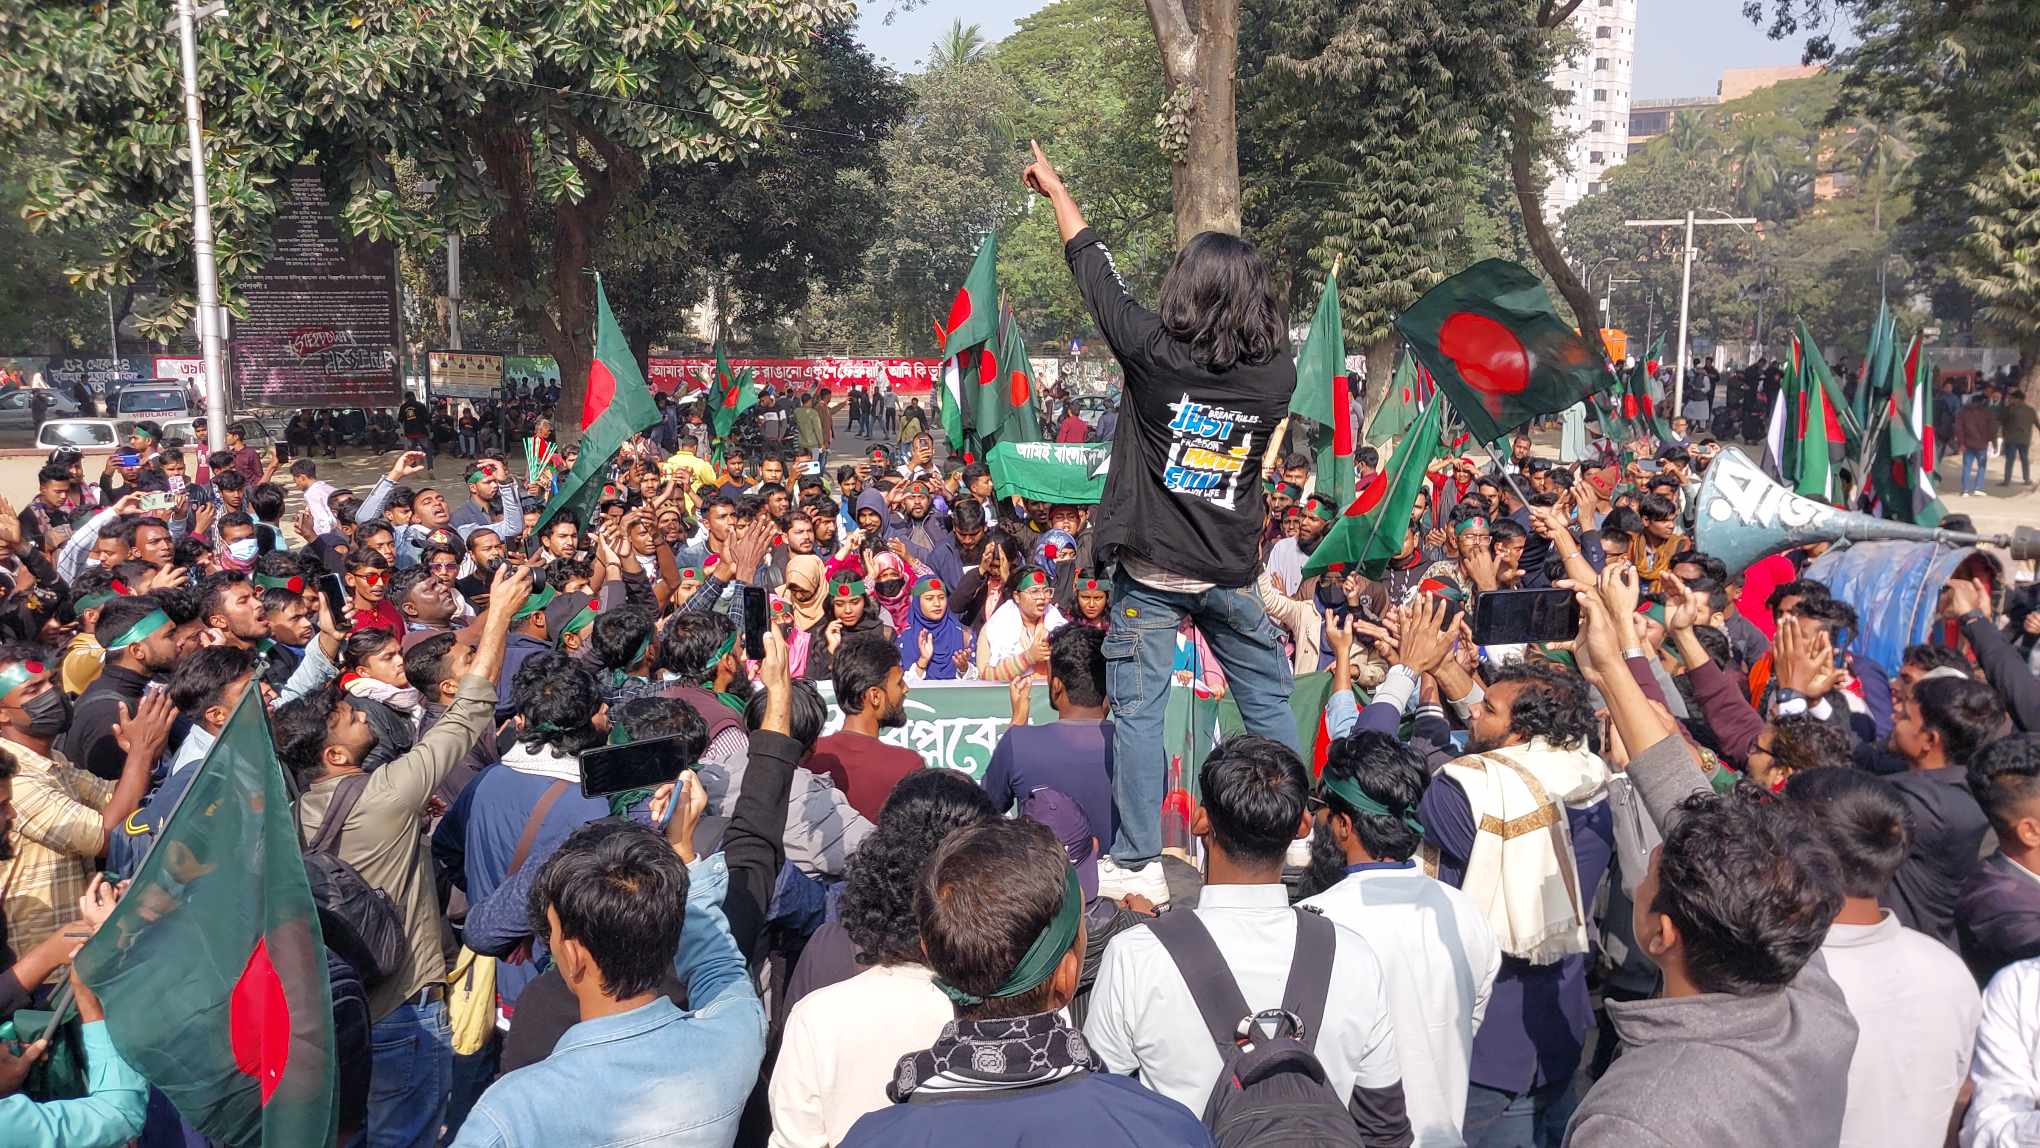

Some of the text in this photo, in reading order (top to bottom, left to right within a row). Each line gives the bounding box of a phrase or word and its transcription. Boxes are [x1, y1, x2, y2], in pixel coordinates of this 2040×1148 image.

[888, 361, 912, 379] আমি
[914, 361, 926, 378] কি
[1208, 409, 1260, 424] BREAK RULES
[1204, 489, 1221, 498] LIFE
